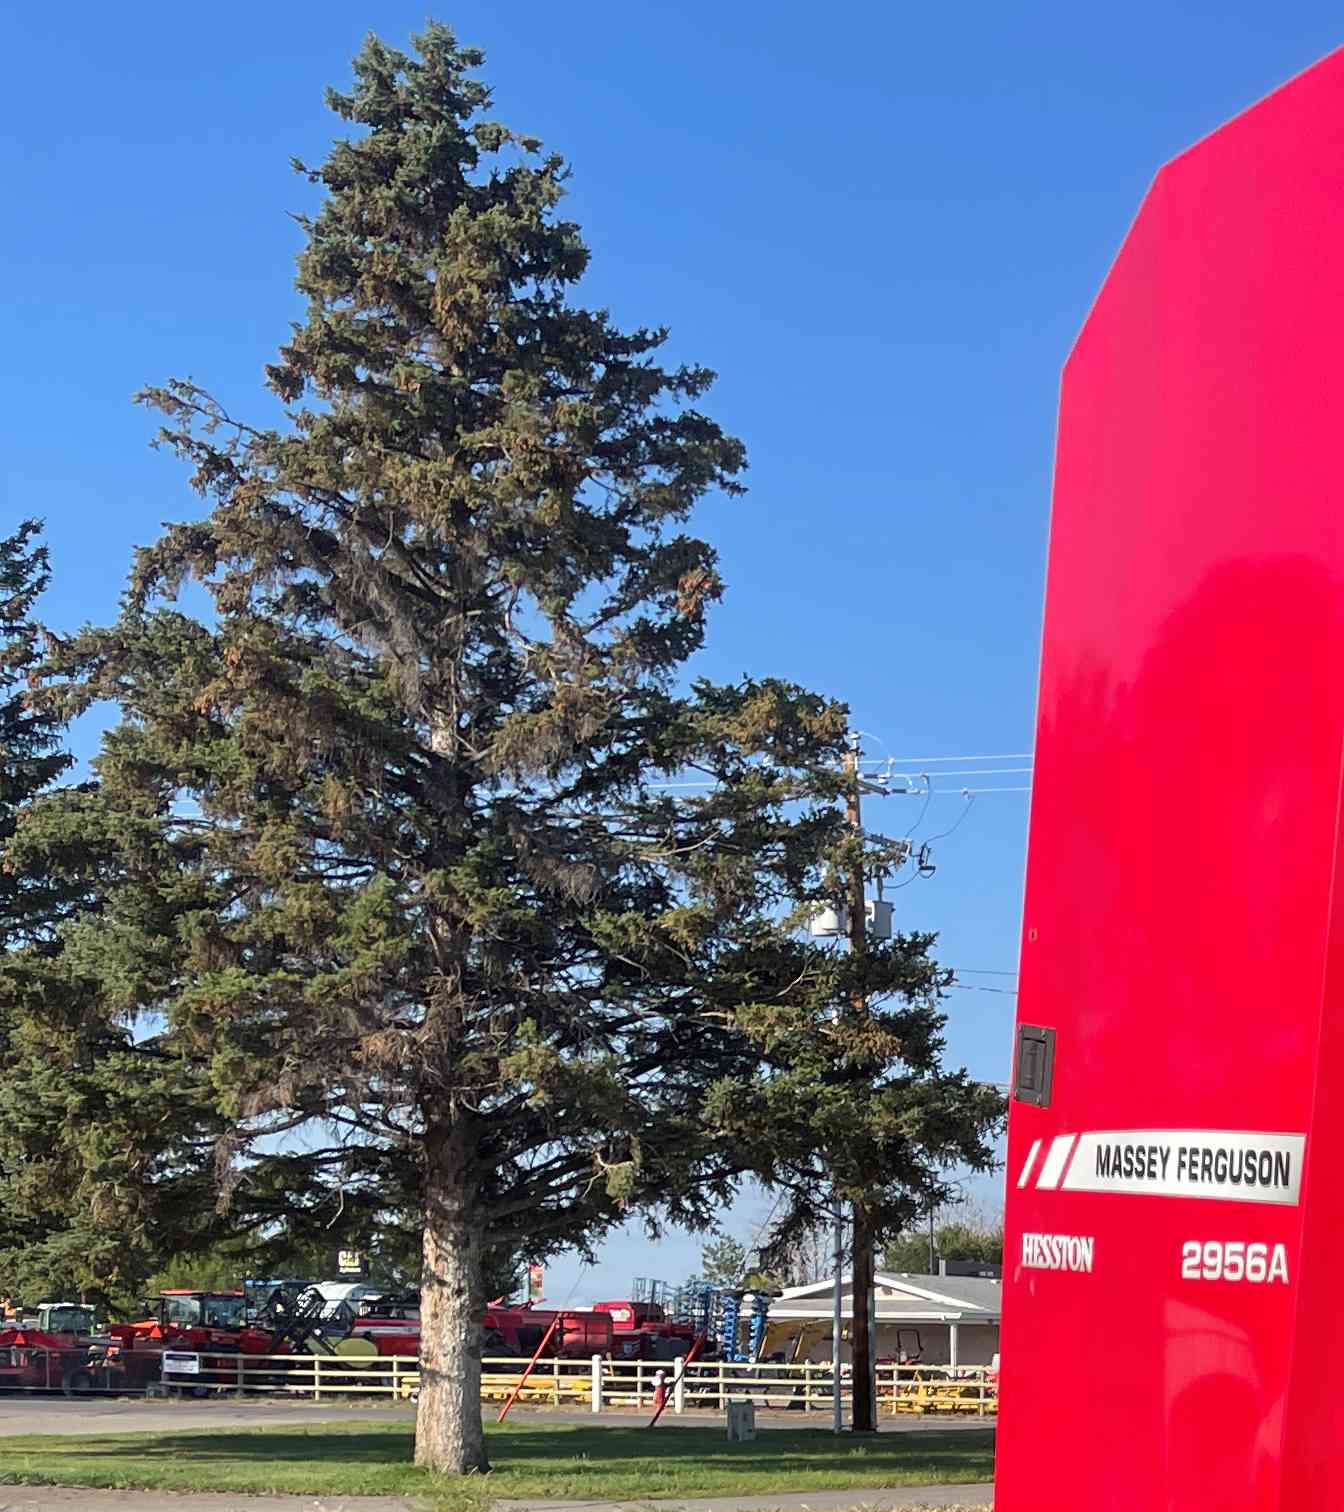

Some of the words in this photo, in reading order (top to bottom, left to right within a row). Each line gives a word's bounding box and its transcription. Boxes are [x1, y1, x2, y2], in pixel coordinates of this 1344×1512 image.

[1096, 1144, 1171, 1180] MASSEY
[1177, 1147, 1291, 1187] FERGUSON
[1021, 1232, 1095, 1273] HESSTON
[1181, 1240, 1290, 1285] 2956A
